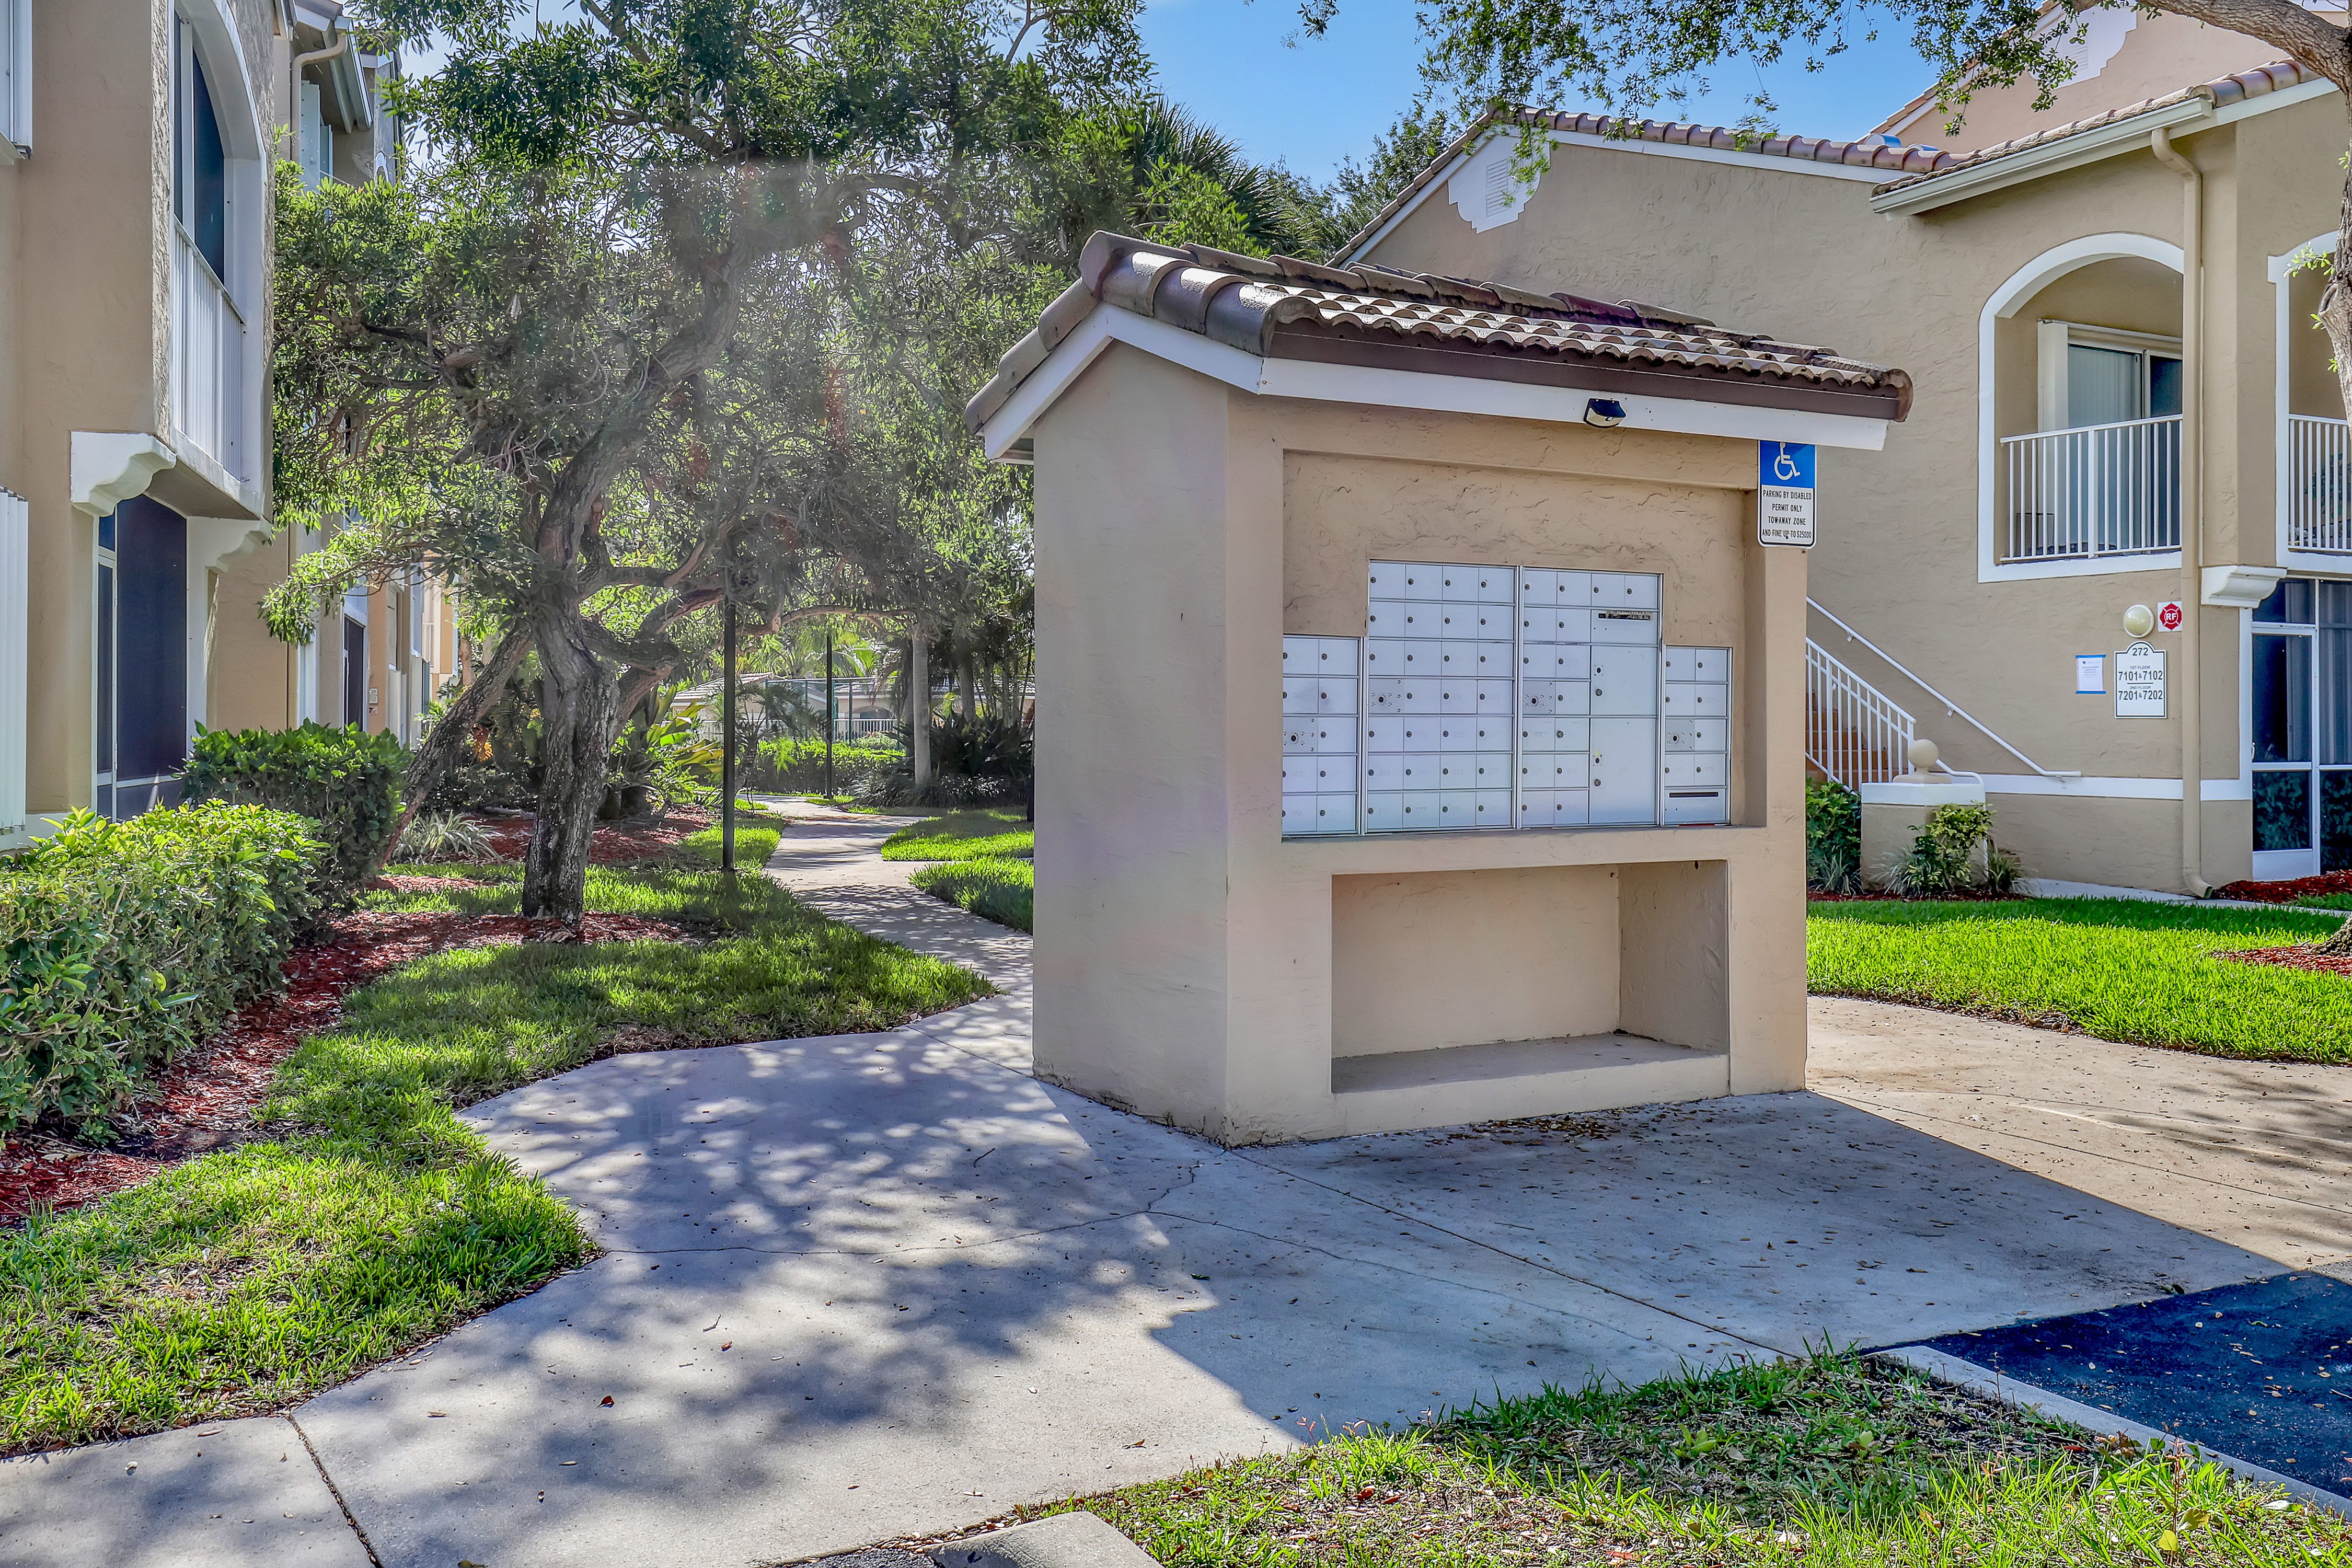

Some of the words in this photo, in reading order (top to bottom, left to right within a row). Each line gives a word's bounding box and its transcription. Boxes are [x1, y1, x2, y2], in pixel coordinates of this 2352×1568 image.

[1763, 490, 1782, 498] PARKING
[1791, 491, 1812, 500] DISABLED
[1768, 516, 1791, 524] TOW-AWAY
[1772, 529, 1782, 537] FINE
[2132, 648, 2148, 656] 272
